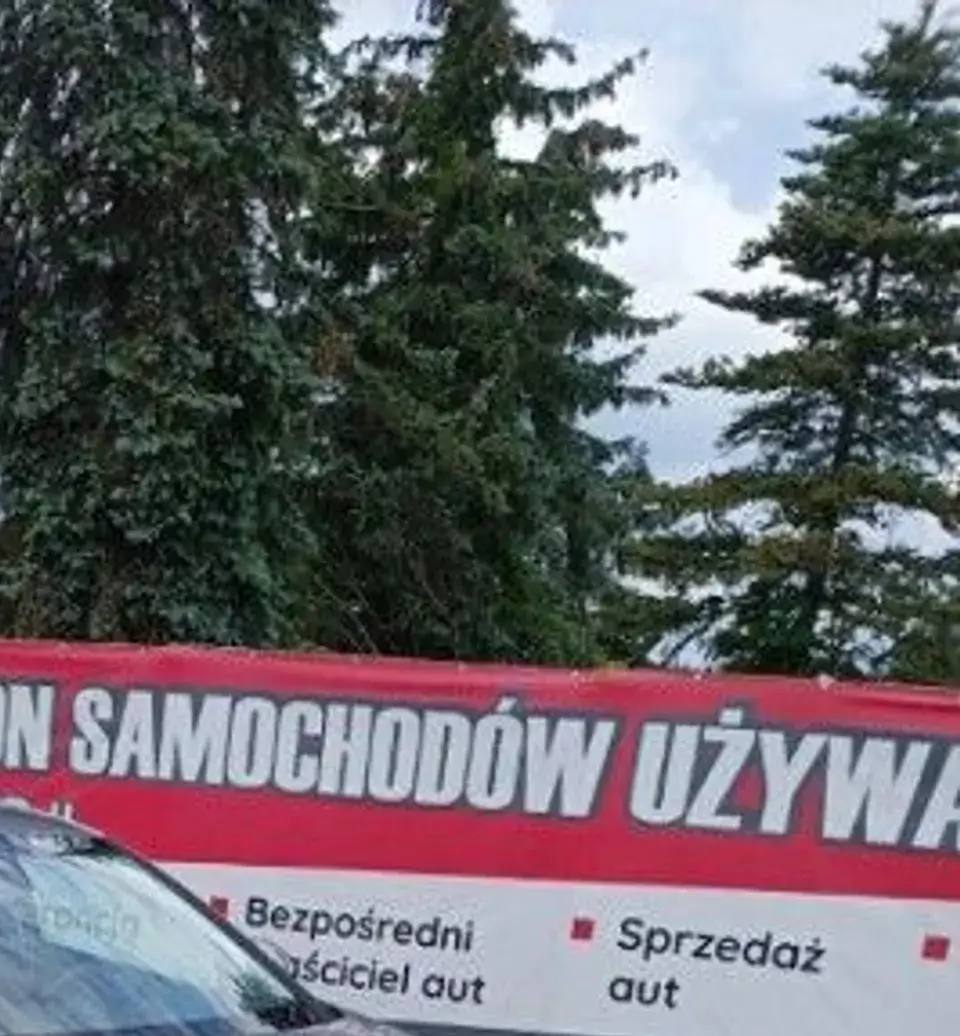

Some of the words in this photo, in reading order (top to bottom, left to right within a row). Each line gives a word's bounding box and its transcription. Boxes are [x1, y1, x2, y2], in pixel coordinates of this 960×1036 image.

[69, 685, 617, 818] SAMOCHODÓW
[244, 896, 475, 953] Bezpośredni
[616, 916, 827, 974] Sprzedaż
[421, 971, 486, 1005] aut
[608, 975, 681, 1009] aut
